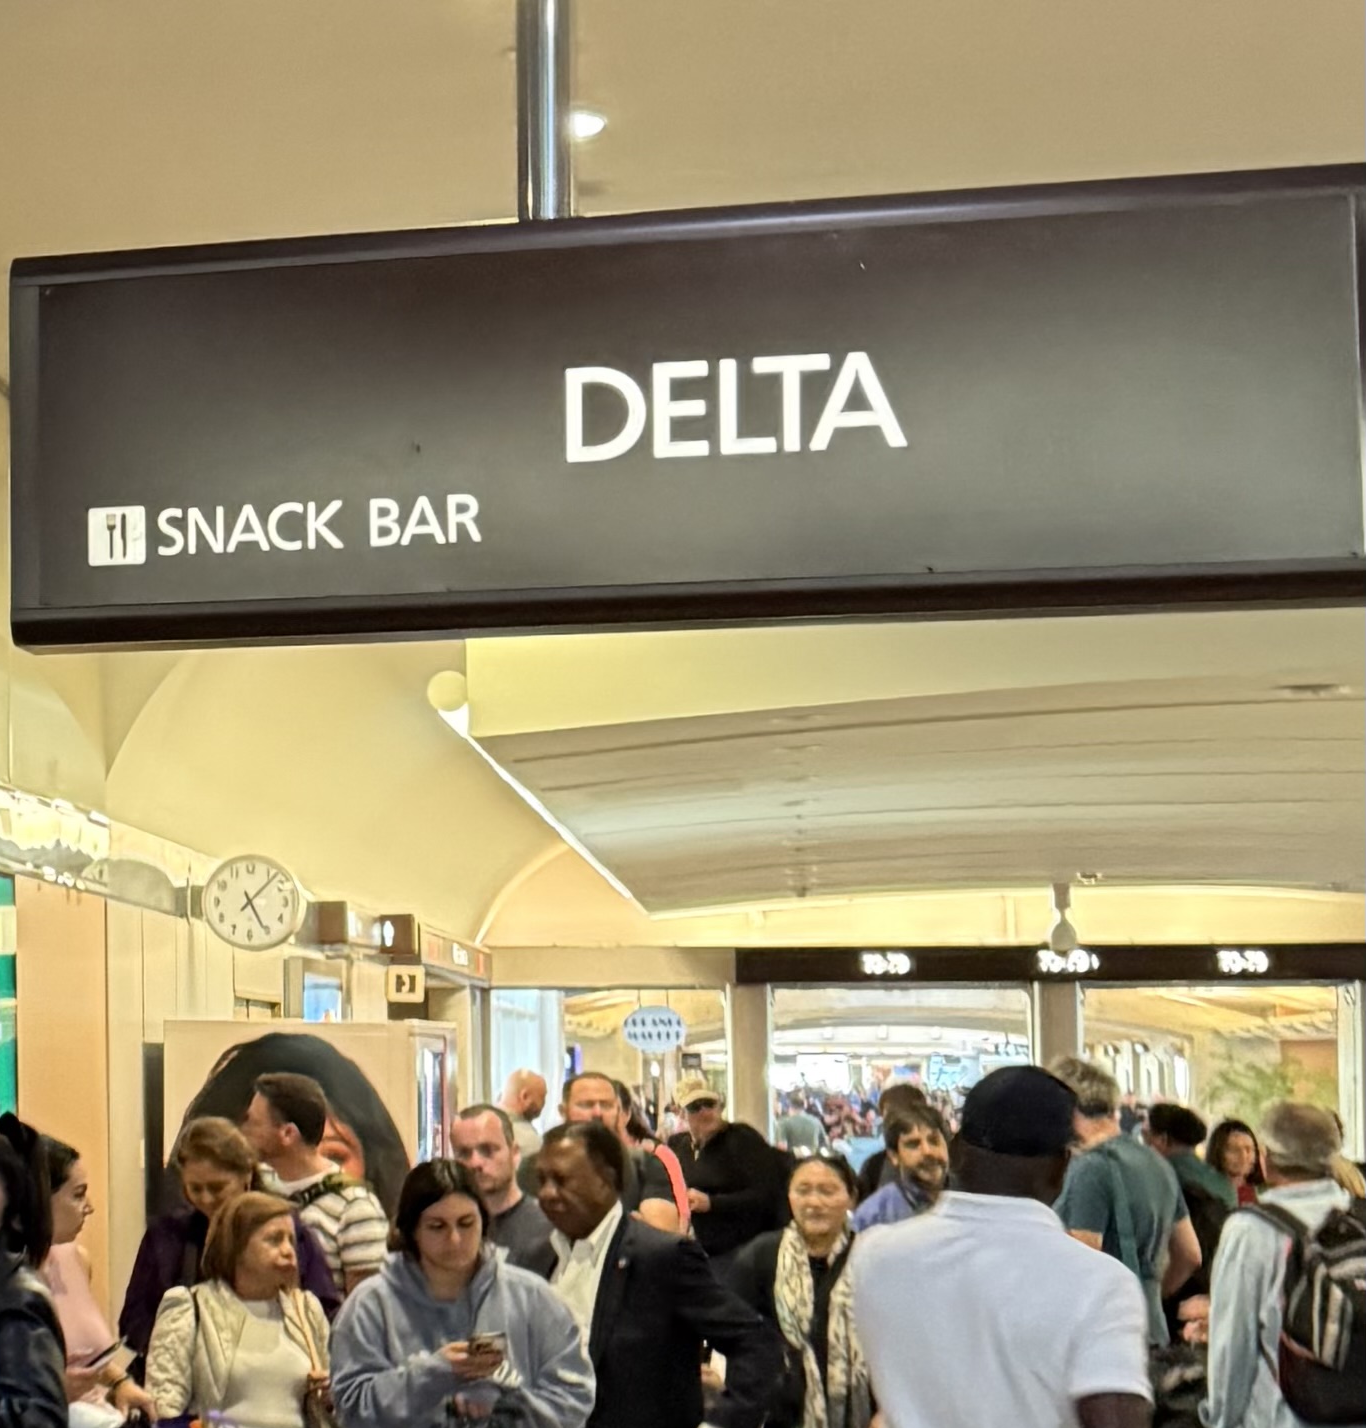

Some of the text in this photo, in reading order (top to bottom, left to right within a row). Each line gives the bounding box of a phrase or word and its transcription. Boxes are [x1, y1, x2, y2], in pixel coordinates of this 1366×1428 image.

[564, 351, 908, 463] DELTA
[156, 494, 482, 556] SNACK BAR
